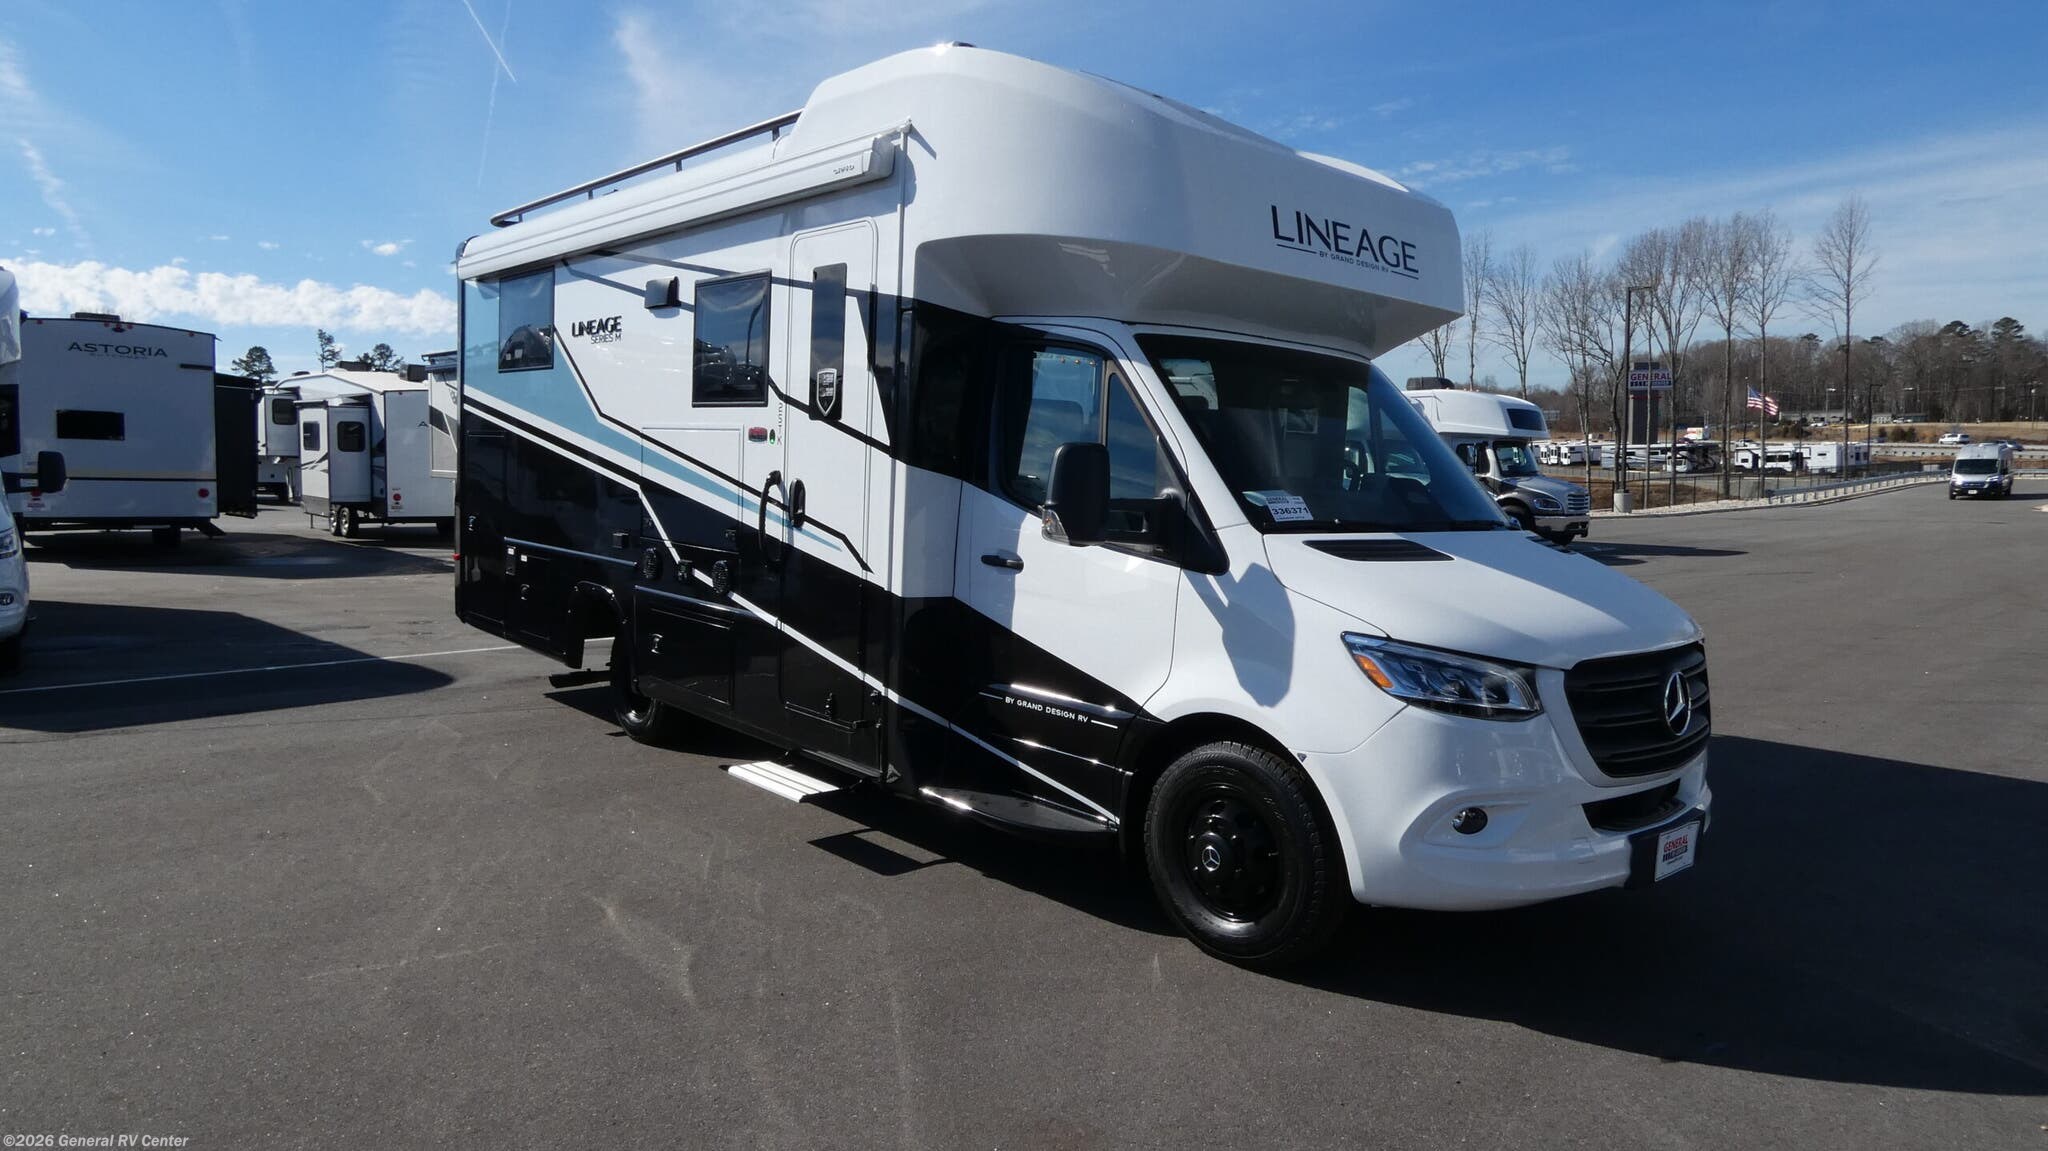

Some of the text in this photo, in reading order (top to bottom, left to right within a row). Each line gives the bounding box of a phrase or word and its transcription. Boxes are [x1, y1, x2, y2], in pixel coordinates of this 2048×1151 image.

[1271, 204, 1420, 274] LINEAGE
[1319, 250, 1329, 258] BY
[1330, 253, 1355, 265] GRAND
[1356, 258, 1380, 271] DESIGN
[571, 315, 623, 338] LINEAGE
[590, 332, 622, 345] SERIES M
[67, 342, 169, 358] ASTORIA
[1630, 372, 1672, 381] GENERAL
[1005, 696, 1089, 723] BY GRAND DESIGN RV
